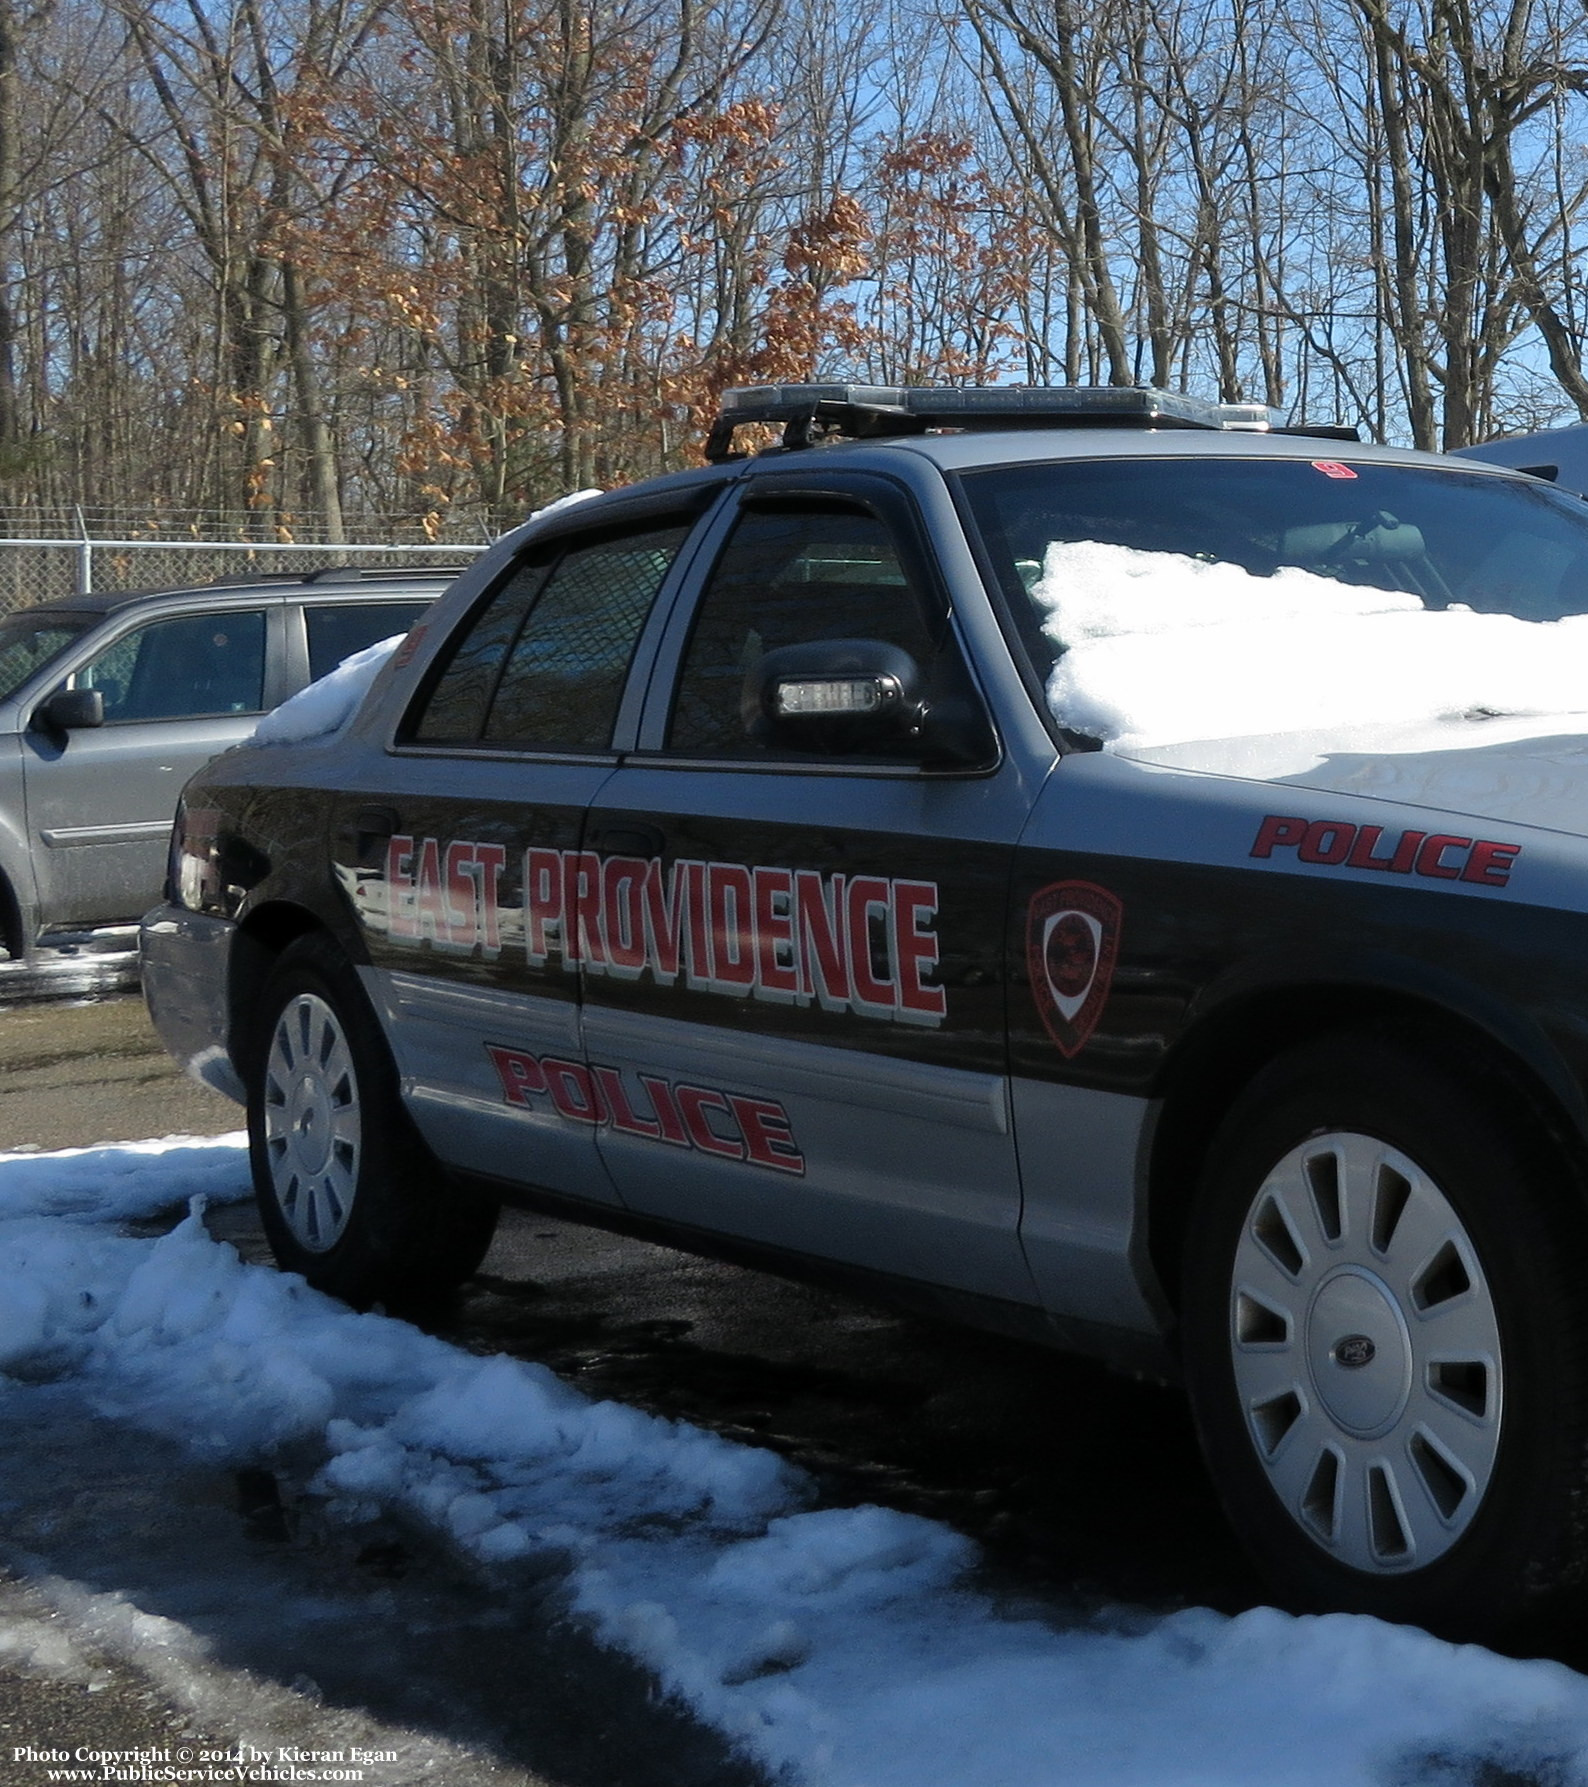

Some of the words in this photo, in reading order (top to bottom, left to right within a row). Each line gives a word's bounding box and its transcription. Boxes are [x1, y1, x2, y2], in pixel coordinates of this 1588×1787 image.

[1249, 815, 1522, 887] POLICE
[384, 834, 506, 959] EAST
[524, 846, 947, 1027] PROVIDENCE
[483, 1042, 806, 1177] POLICE
